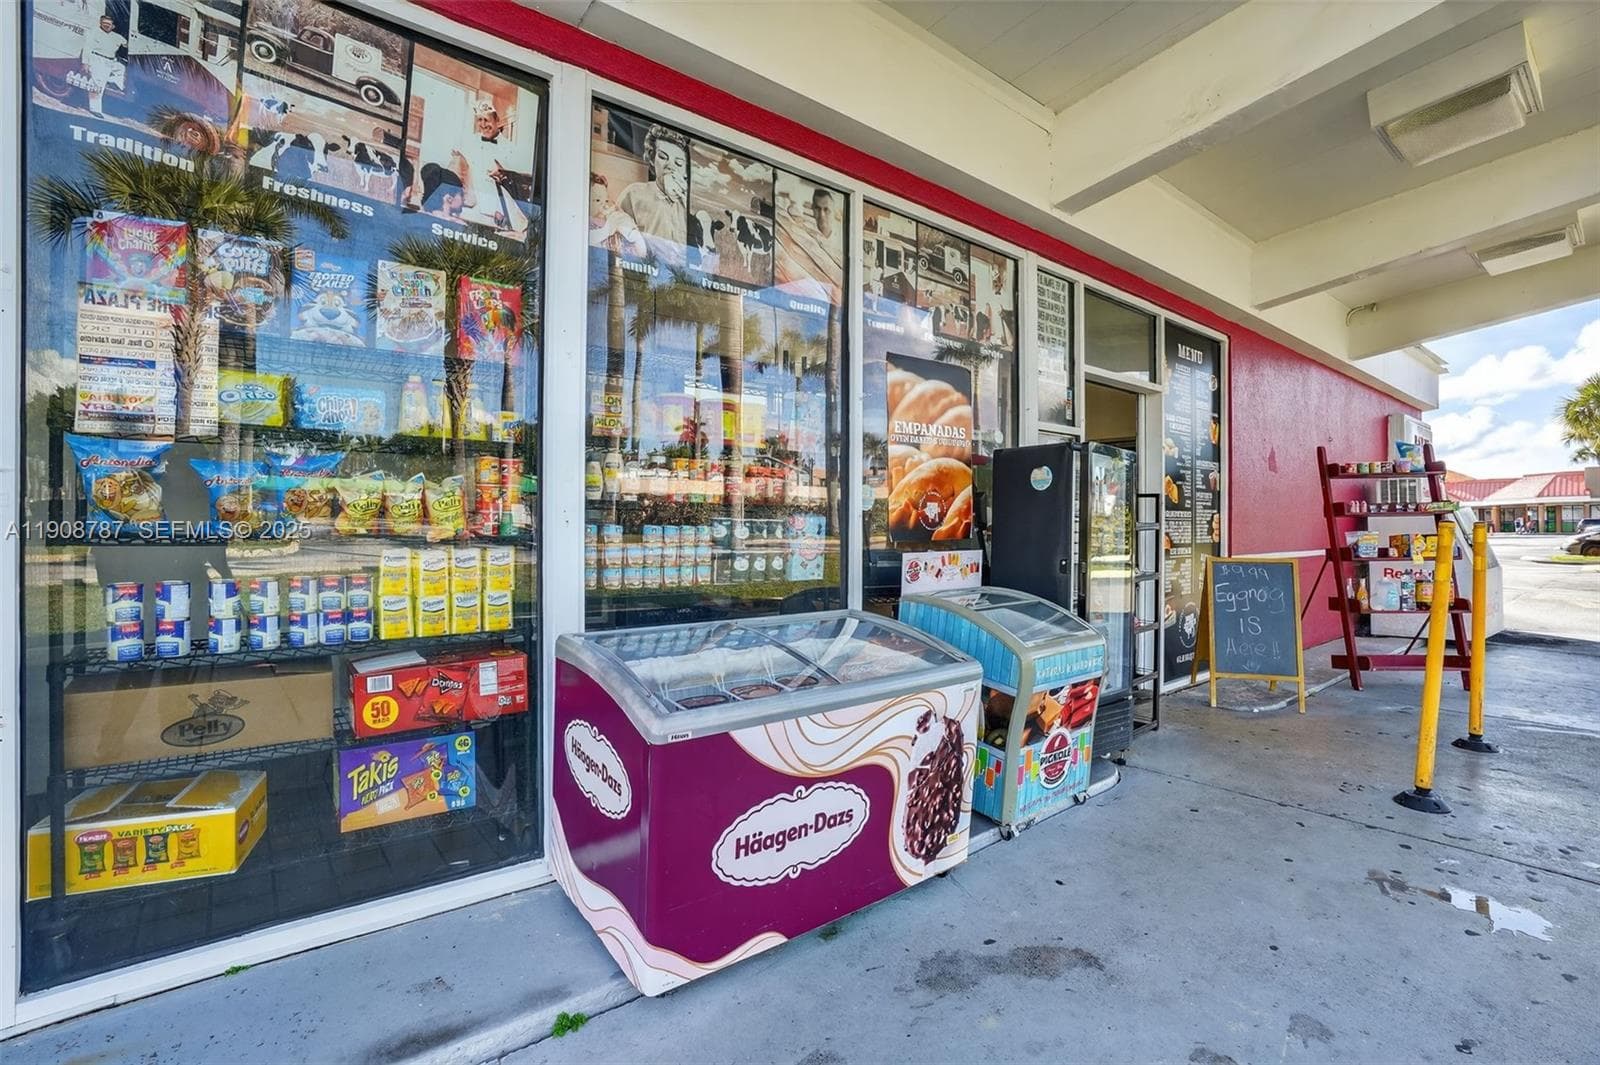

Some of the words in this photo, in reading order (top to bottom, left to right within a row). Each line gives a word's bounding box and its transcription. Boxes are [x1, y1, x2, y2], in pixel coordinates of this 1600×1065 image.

[69, 124, 195, 173] Tradition
[262, 175, 375, 217] Freshness
[431, 222, 498, 251] Service
[615, 256, 659, 277] Family
[701, 277, 761, 300] Freshness
[789, 299, 826, 316] Quality
[1177, 343, 1203, 364] MENU
[894, 420, 966, 439] EMPANADAS
[1214, 582, 1286, 614] Eggnog
[1239, 615, 1262, 636] IS
[431, 677, 464, 689] Doritos
[371, 700, 391, 718] 50
[178, 719, 234, 738] Pelly
[571, 735, 622, 797] Häagen-Dazs
[347, 756, 399, 801] Takis
[165, 823, 196, 833] PACK
[735, 808, 854, 860] Häagen-Dazs
